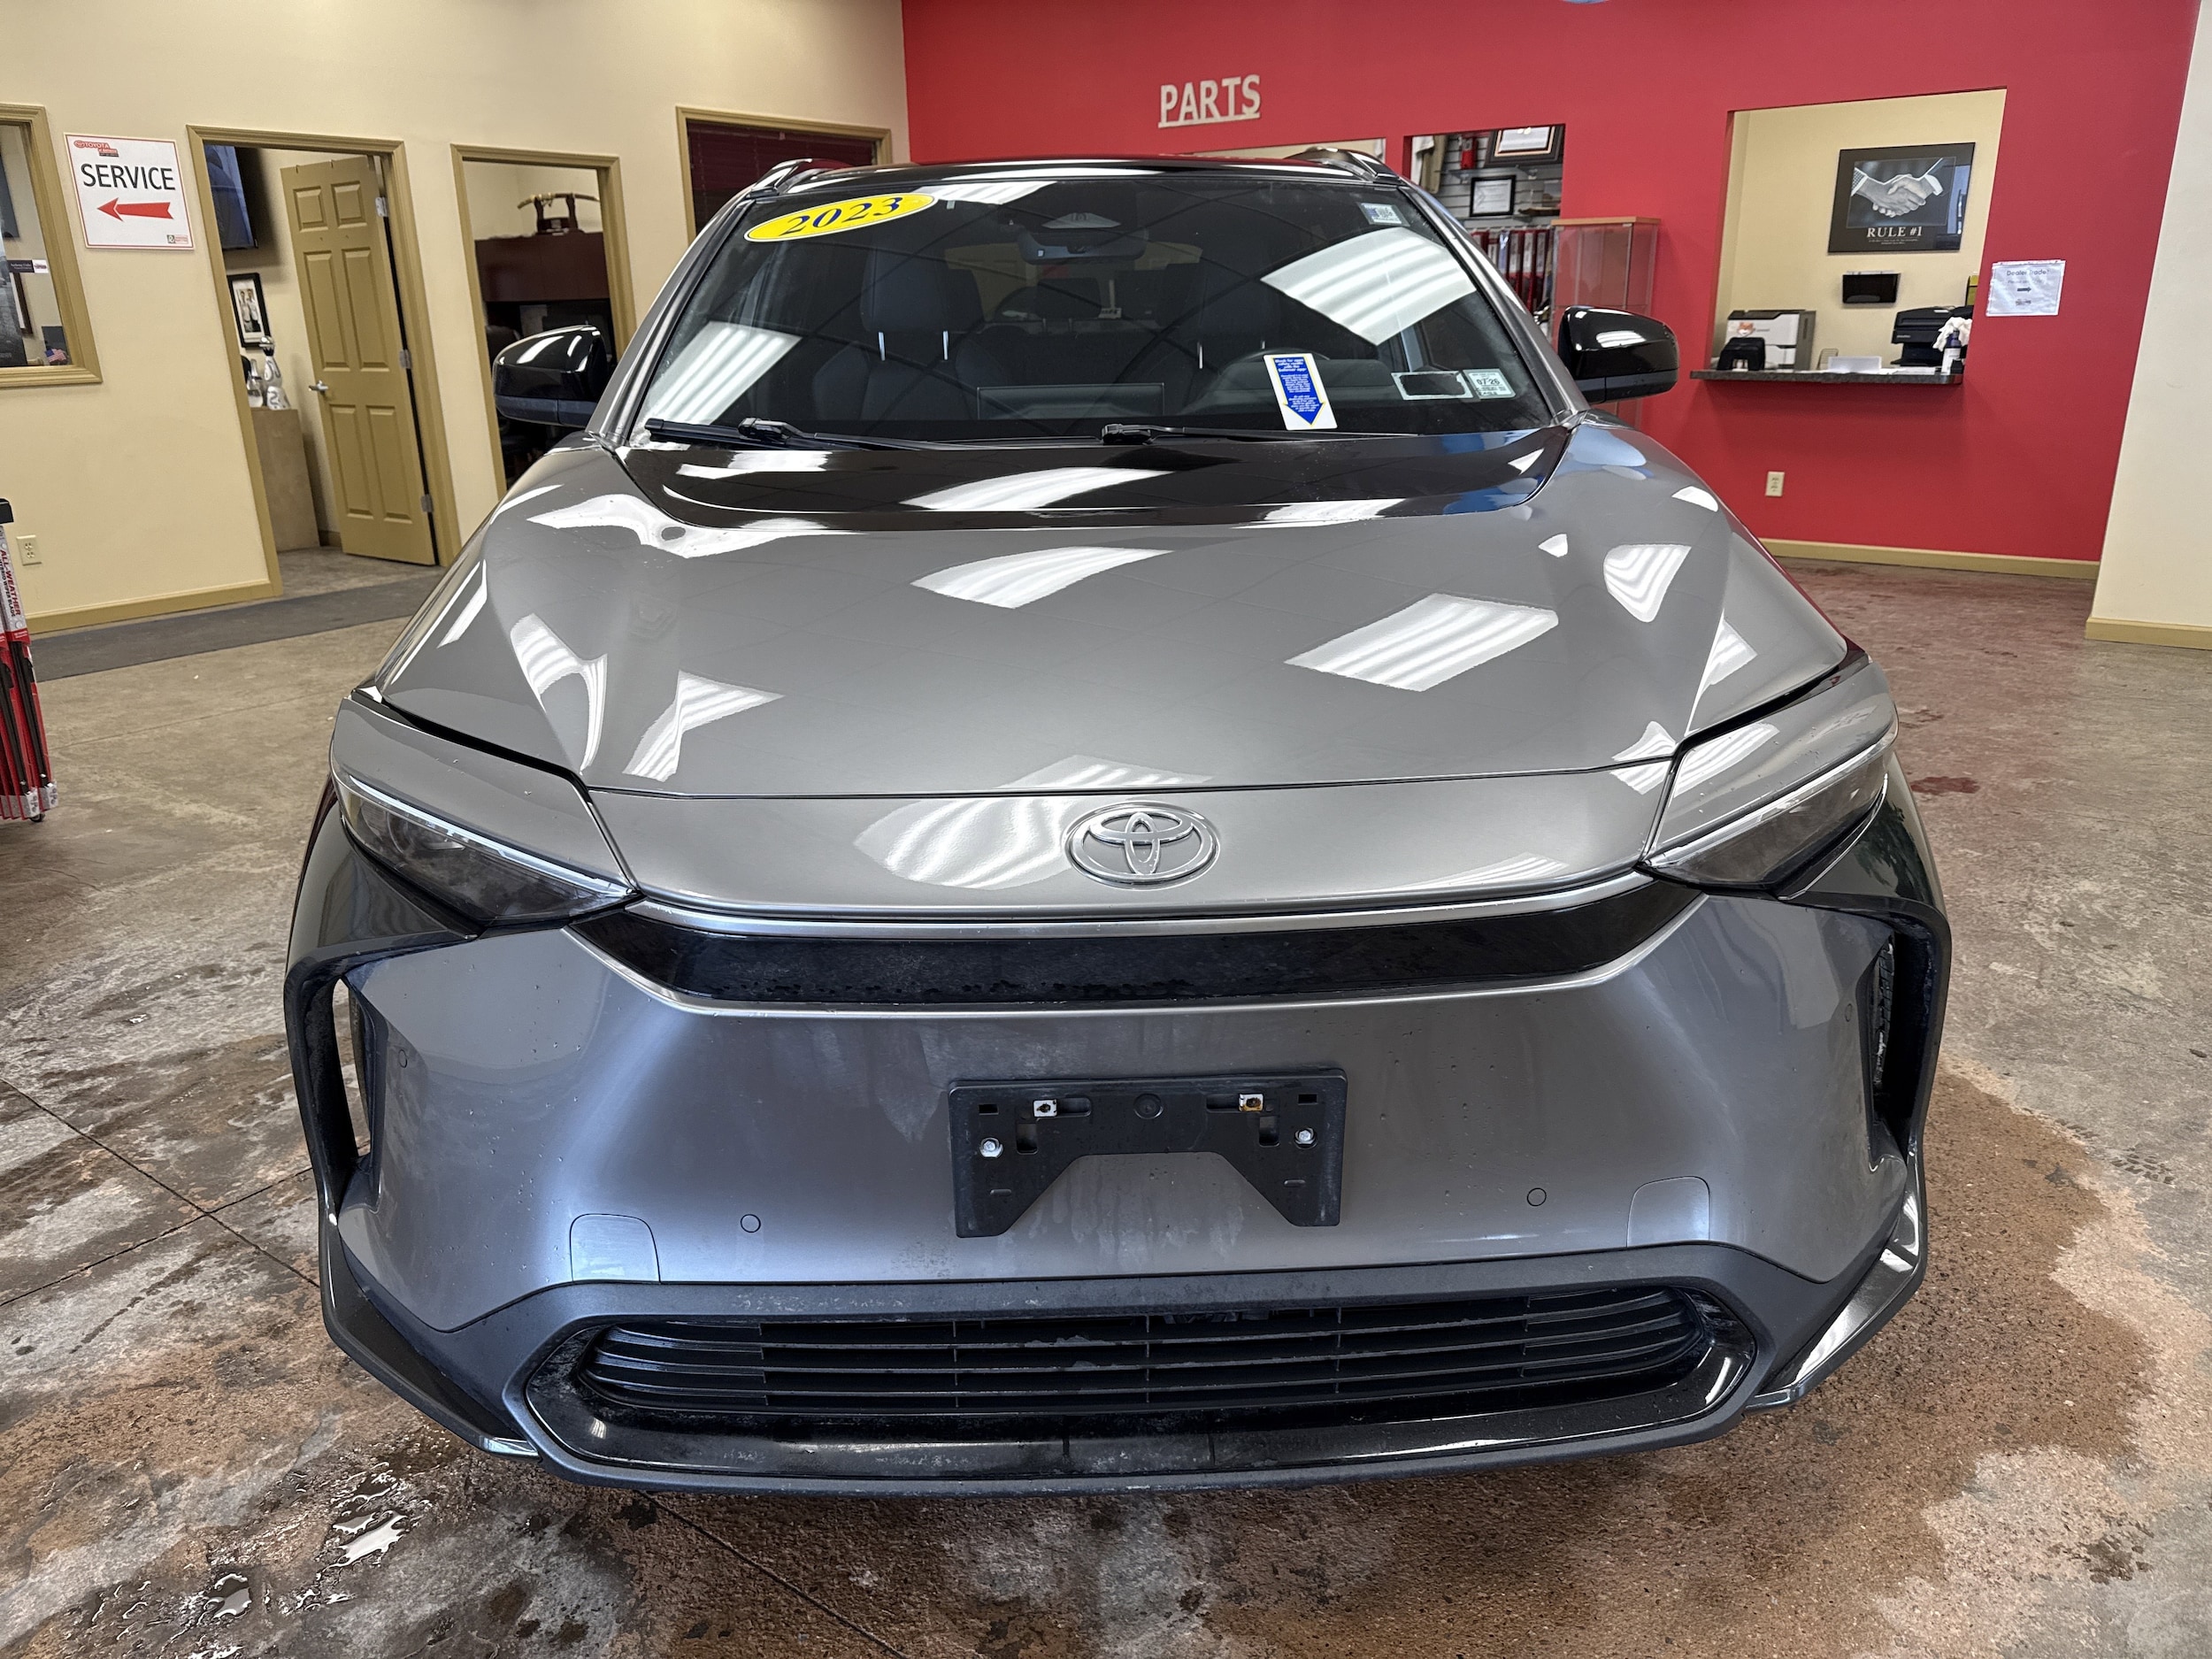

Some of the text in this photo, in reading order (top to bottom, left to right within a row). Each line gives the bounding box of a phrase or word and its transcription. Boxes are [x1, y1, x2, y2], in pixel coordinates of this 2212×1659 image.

[1159, 74, 1261, 126] PARTS
[81, 163, 176, 190] SERVICE
[779, 196, 903, 236] 2023
[1867, 226, 1922, 237] RULE #1
[0, 549, 21, 616] ALL-WEATHER
